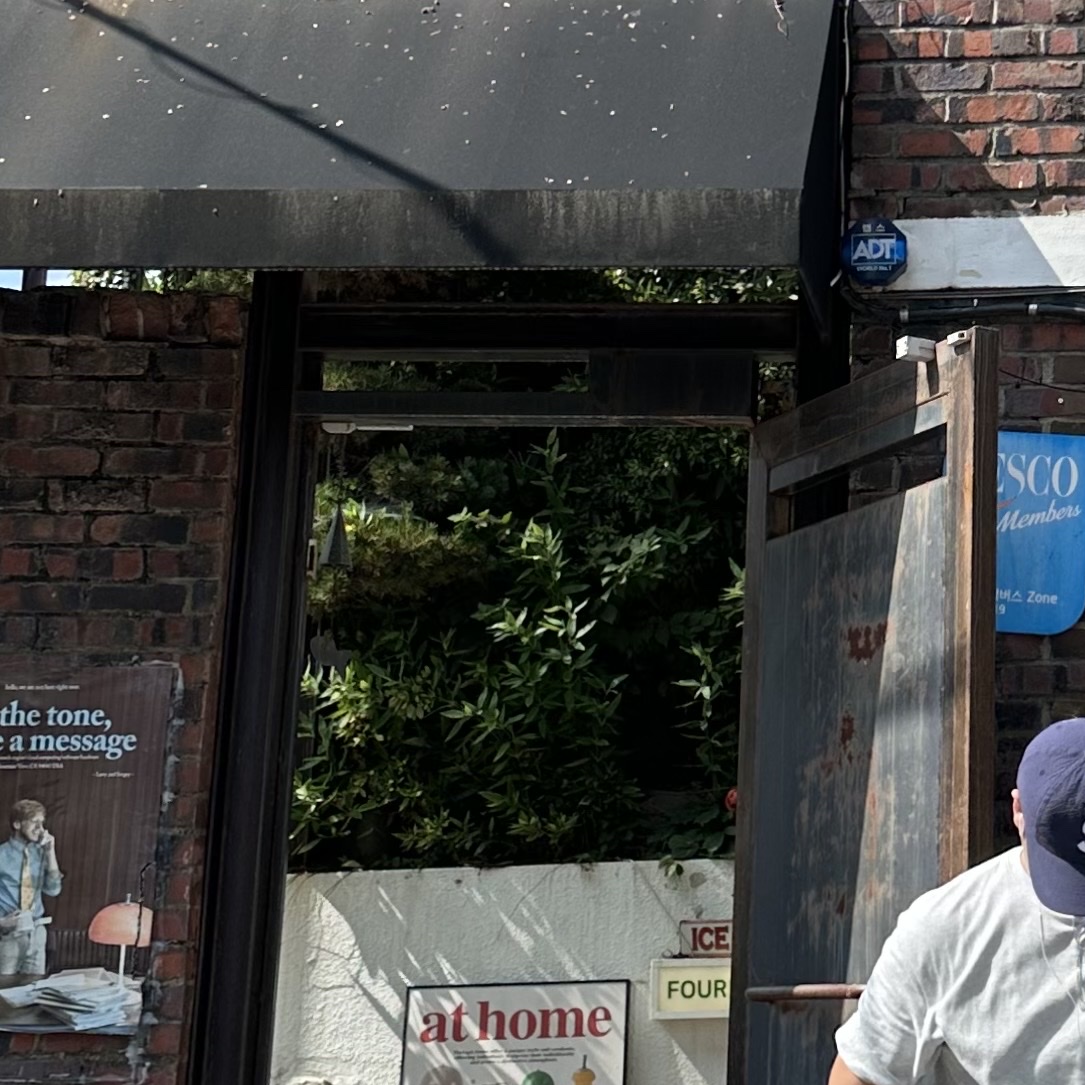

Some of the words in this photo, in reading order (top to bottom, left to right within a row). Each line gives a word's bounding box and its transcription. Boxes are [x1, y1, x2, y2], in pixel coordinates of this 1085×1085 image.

[852, 239, 896, 260] ADT
[997, 499, 1082, 533] Members
[996, 588, 1023, 603] 버스
[1027, 590, 1058, 605] Zone
[0, 699, 41, 726] the
[47, 706, 112, 732] tone,
[9, 734, 25, 752] a
[29, 733, 137, 760] message
[691, 925, 730, 952] ICE
[667, 979, 727, 999] FOUR
[419, 1002, 469, 1043] at
[476, 1000, 612, 1041] home
